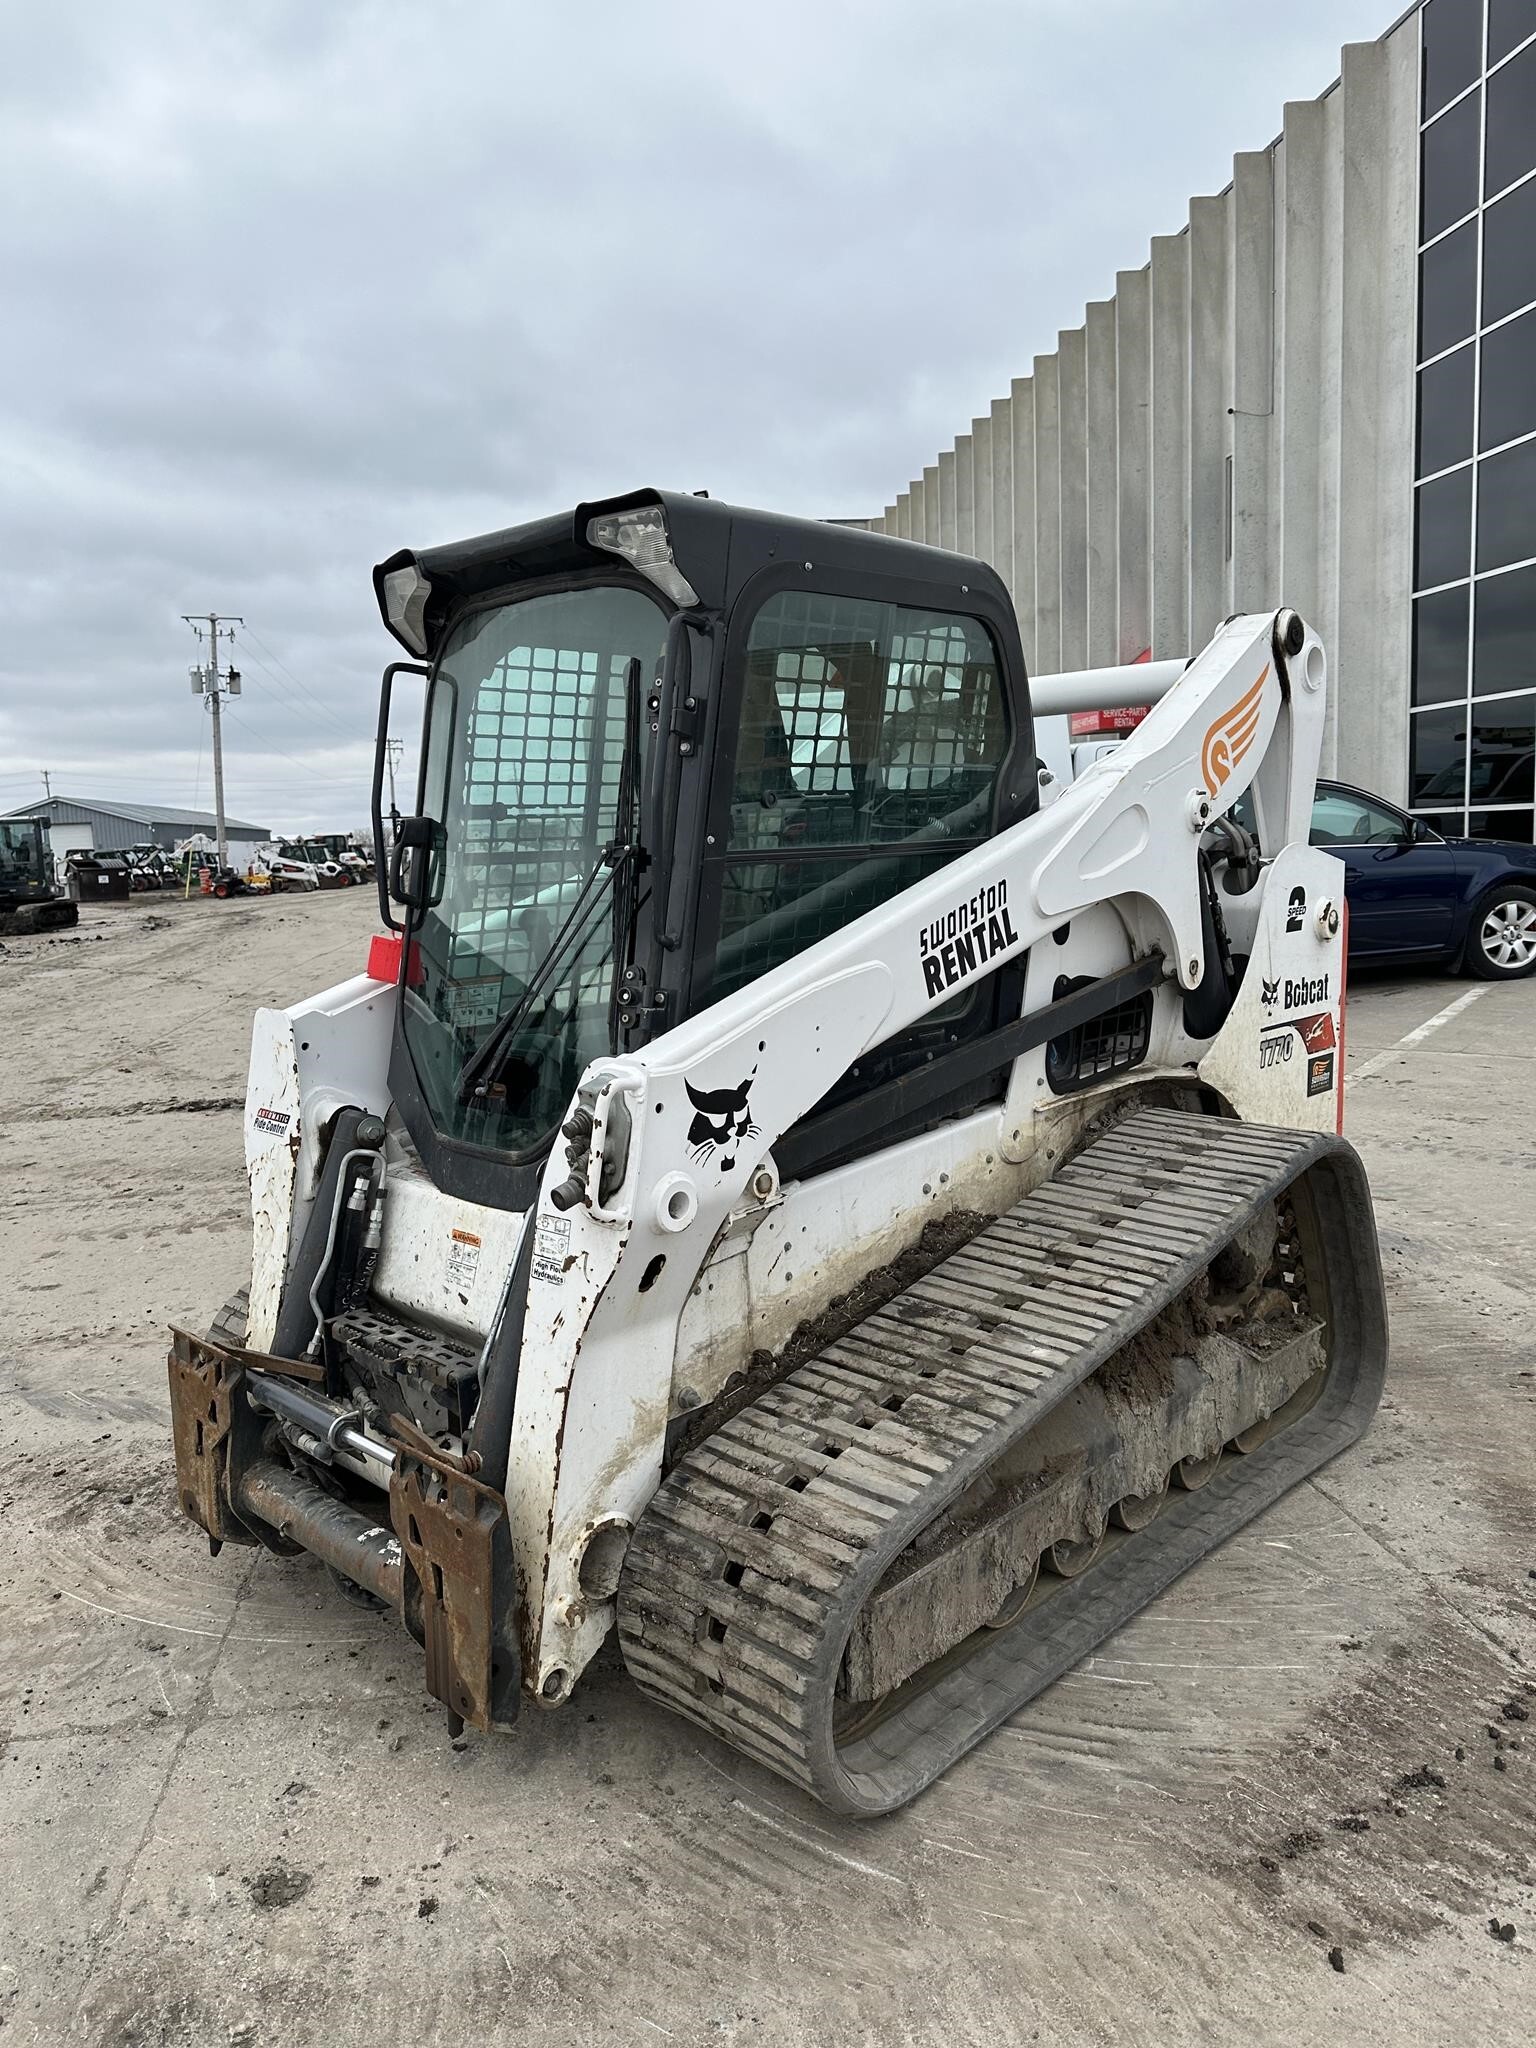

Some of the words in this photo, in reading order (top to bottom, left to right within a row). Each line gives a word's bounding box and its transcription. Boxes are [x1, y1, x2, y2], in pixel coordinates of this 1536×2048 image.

[1114, 717, 1136, 727] RENTAL
[1286, 886, 1306, 933] 2
[1287, 905, 1307, 917] SPEED
[922, 907, 1018, 999] RENTAL
[1284, 973, 1329, 1010] Bobcat
[1260, 1033, 1294, 1069] T770
[258, 1109, 290, 1124] AUTOMATIC
[253, 1117, 265, 1129] Ride
[266, 1120, 287, 1135] Control
[457, 1232, 480, 1245] WARNING
[534, 1269, 564, 1284] Hydraulics
